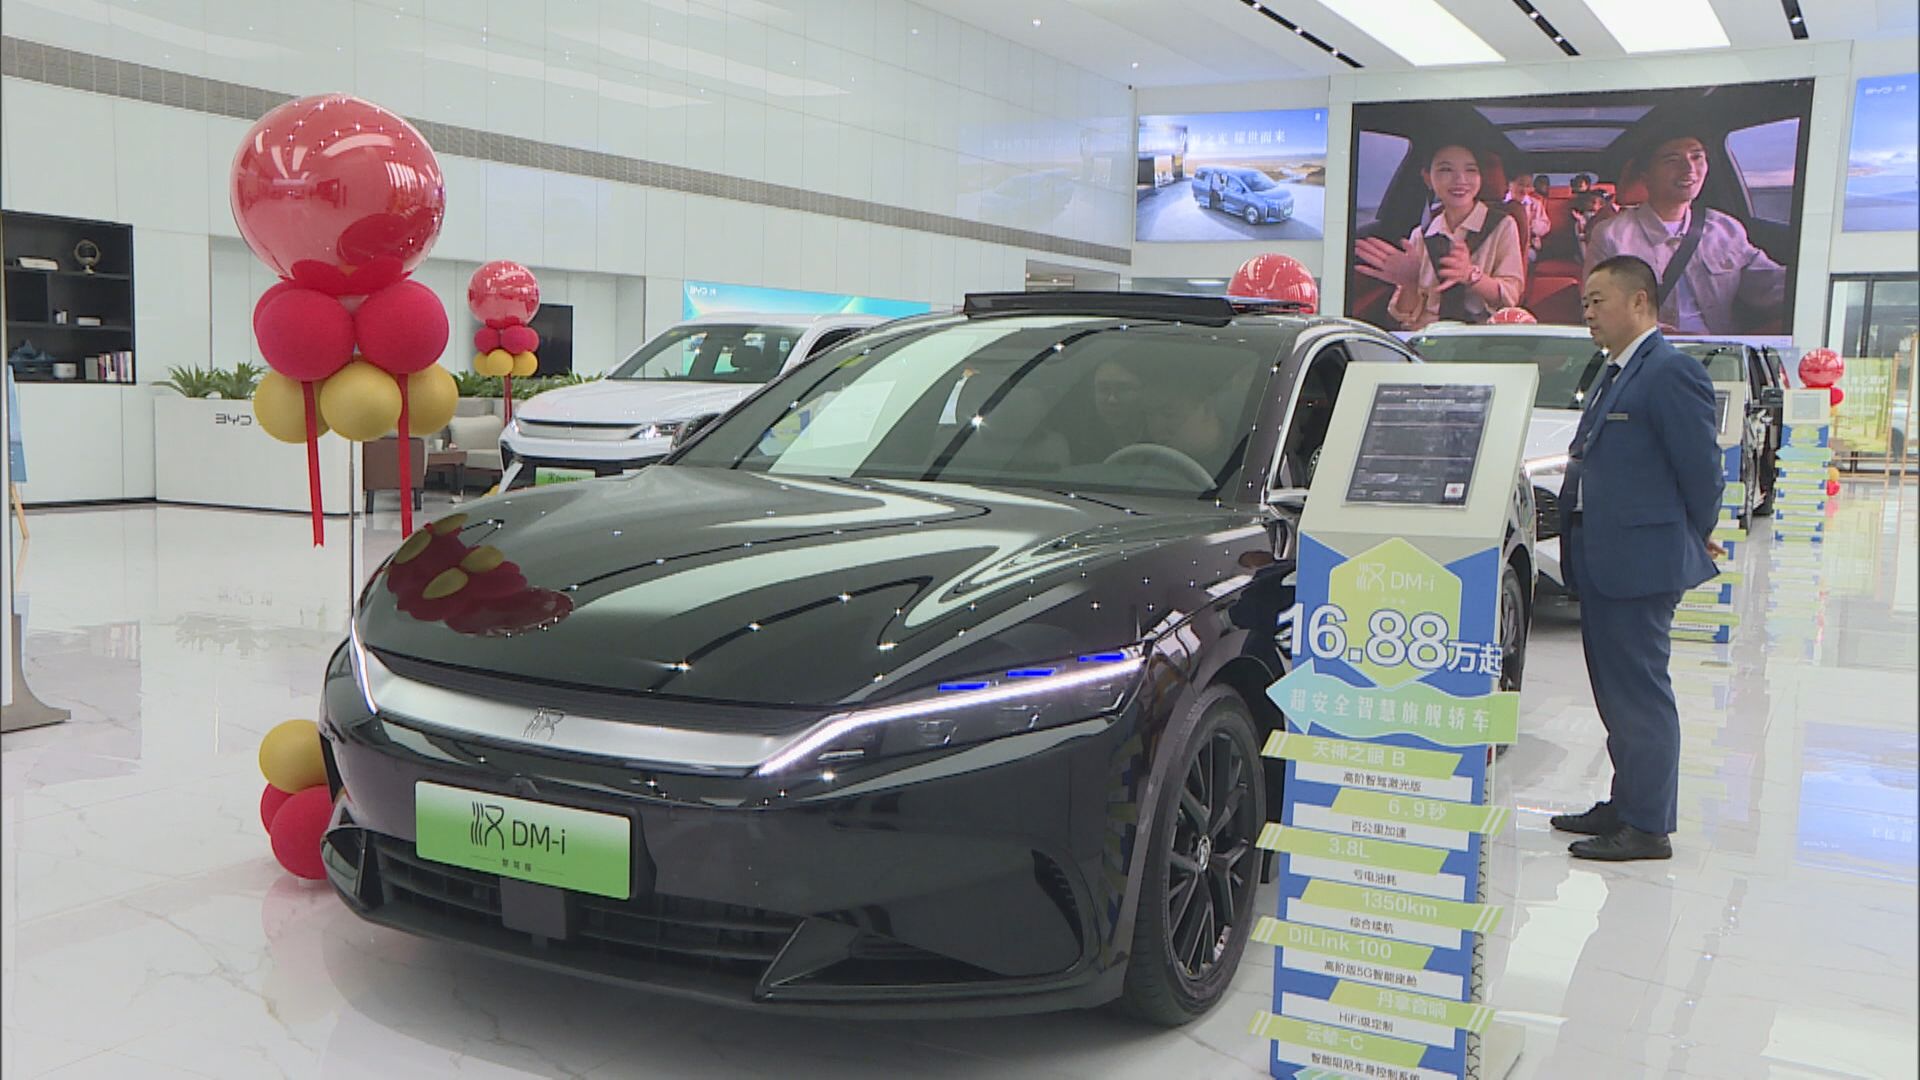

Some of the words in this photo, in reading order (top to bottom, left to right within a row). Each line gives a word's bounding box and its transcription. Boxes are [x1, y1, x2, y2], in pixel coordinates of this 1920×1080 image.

[216, 413, 252, 426] BYD
[1391, 571, 1436, 593] DM-i
[1289, 687, 1490, 732] 超安全智慧旗舰轿车
[1312, 740, 1385, 767] 天神之眼
[1391, 751, 1406, 767] B
[1388, 799, 1447, 821] 6.9秒
[511, 820, 567, 855] DM-i
[1351, 819, 1407, 839] 百公里加速
[1328, 838, 1371, 859] 3.8L
[1361, 891, 1438, 919] 1350km
[1349, 916, 1395, 934] 综合续航
[1288, 927, 1351, 953] DiLink
[1358, 939, 1393, 960] 100
